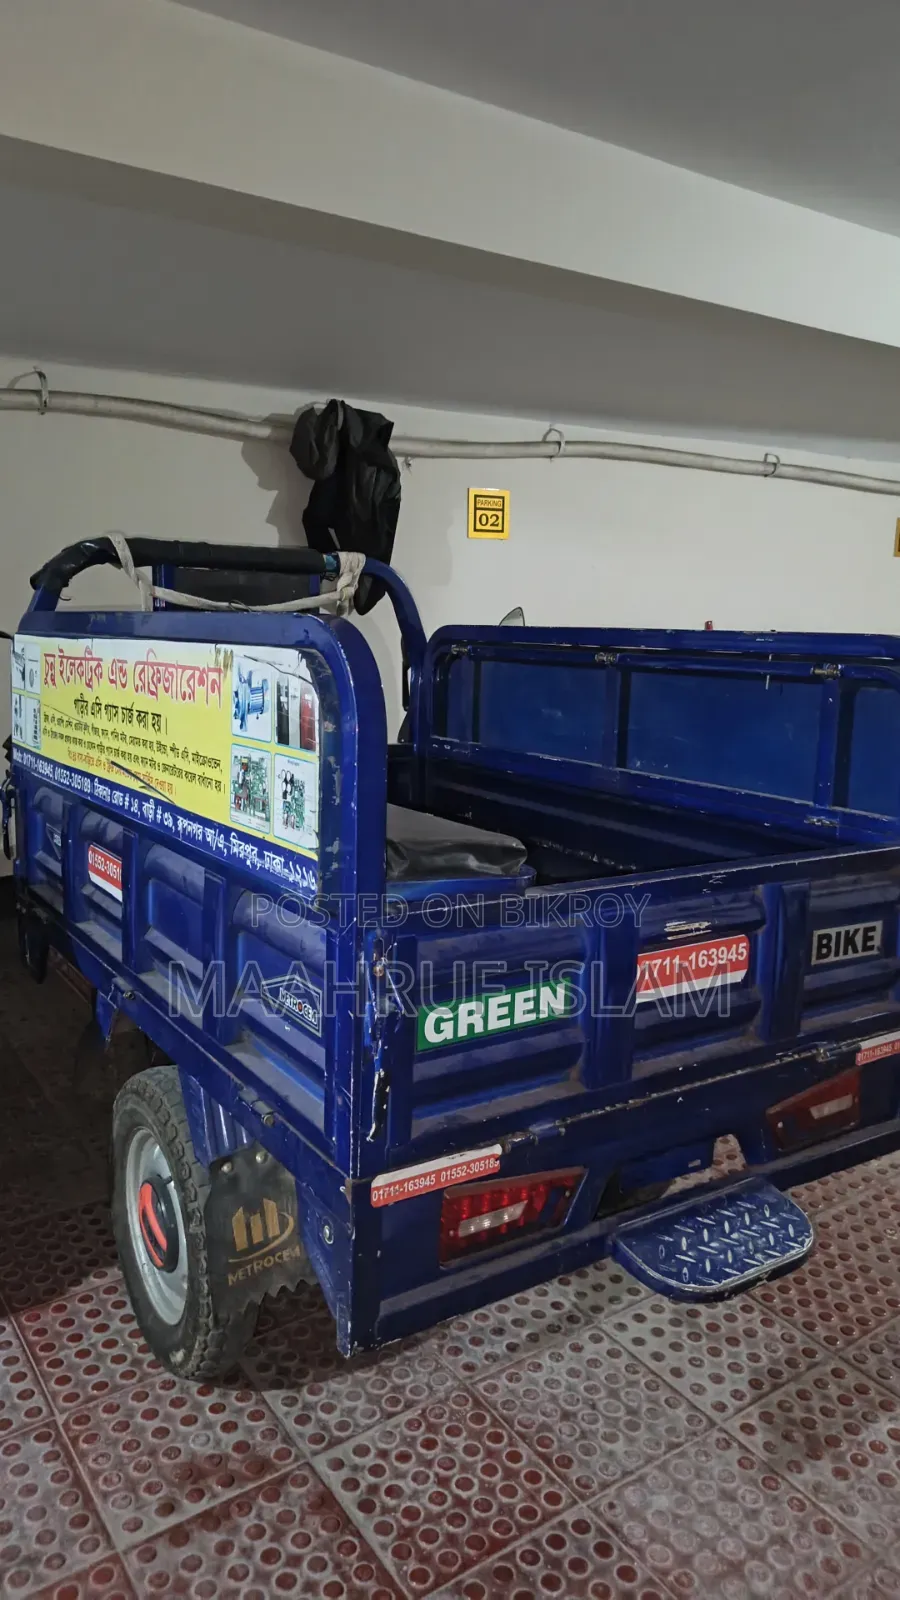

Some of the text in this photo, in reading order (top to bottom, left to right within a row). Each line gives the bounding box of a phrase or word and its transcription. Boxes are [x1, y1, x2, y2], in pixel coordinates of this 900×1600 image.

[477, 498, 502, 508] PARKING
[478, 512, 500, 527] 02
[58, 644, 103, 692] ইলেকট্রিক
[133, 648, 223, 709] রেফ্রিজারেশন
[91, 695, 102, 720] এসি
[104, 702, 119, 723] গ্যাস
[121, 701, 135, 727] চার্জ
[135, 709, 149, 731] করা
[151, 712, 162, 736] হয়
[111, 789, 124, 807] রোড
[124, 792, 130, 810] #
[156, 805, 162, 824] #
[230, 832, 260, 870] মিরপুর,
[88, 850, 122, 882] 01552-3051
[815, 925, 877, 961] BIKE
[424, 983, 565, 1044] GREEN
[372, 1174, 436, 1202] 01711-163945
